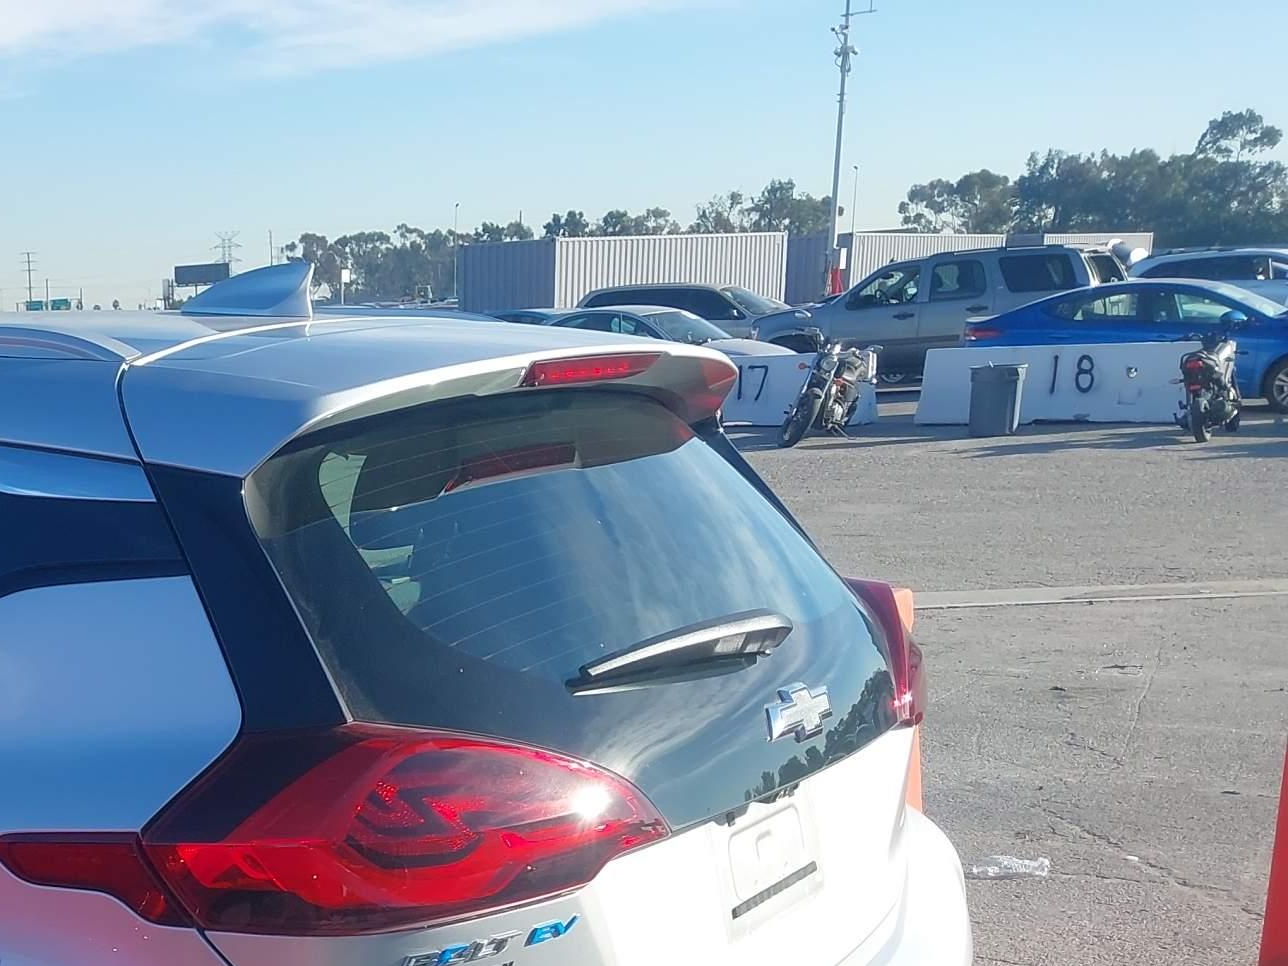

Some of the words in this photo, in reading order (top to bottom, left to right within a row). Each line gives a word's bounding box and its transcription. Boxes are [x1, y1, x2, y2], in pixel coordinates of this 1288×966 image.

[737, 364, 768, 402] 17
[1050, 354, 1094, 394] 18
[524, 913, 581, 948] EV
